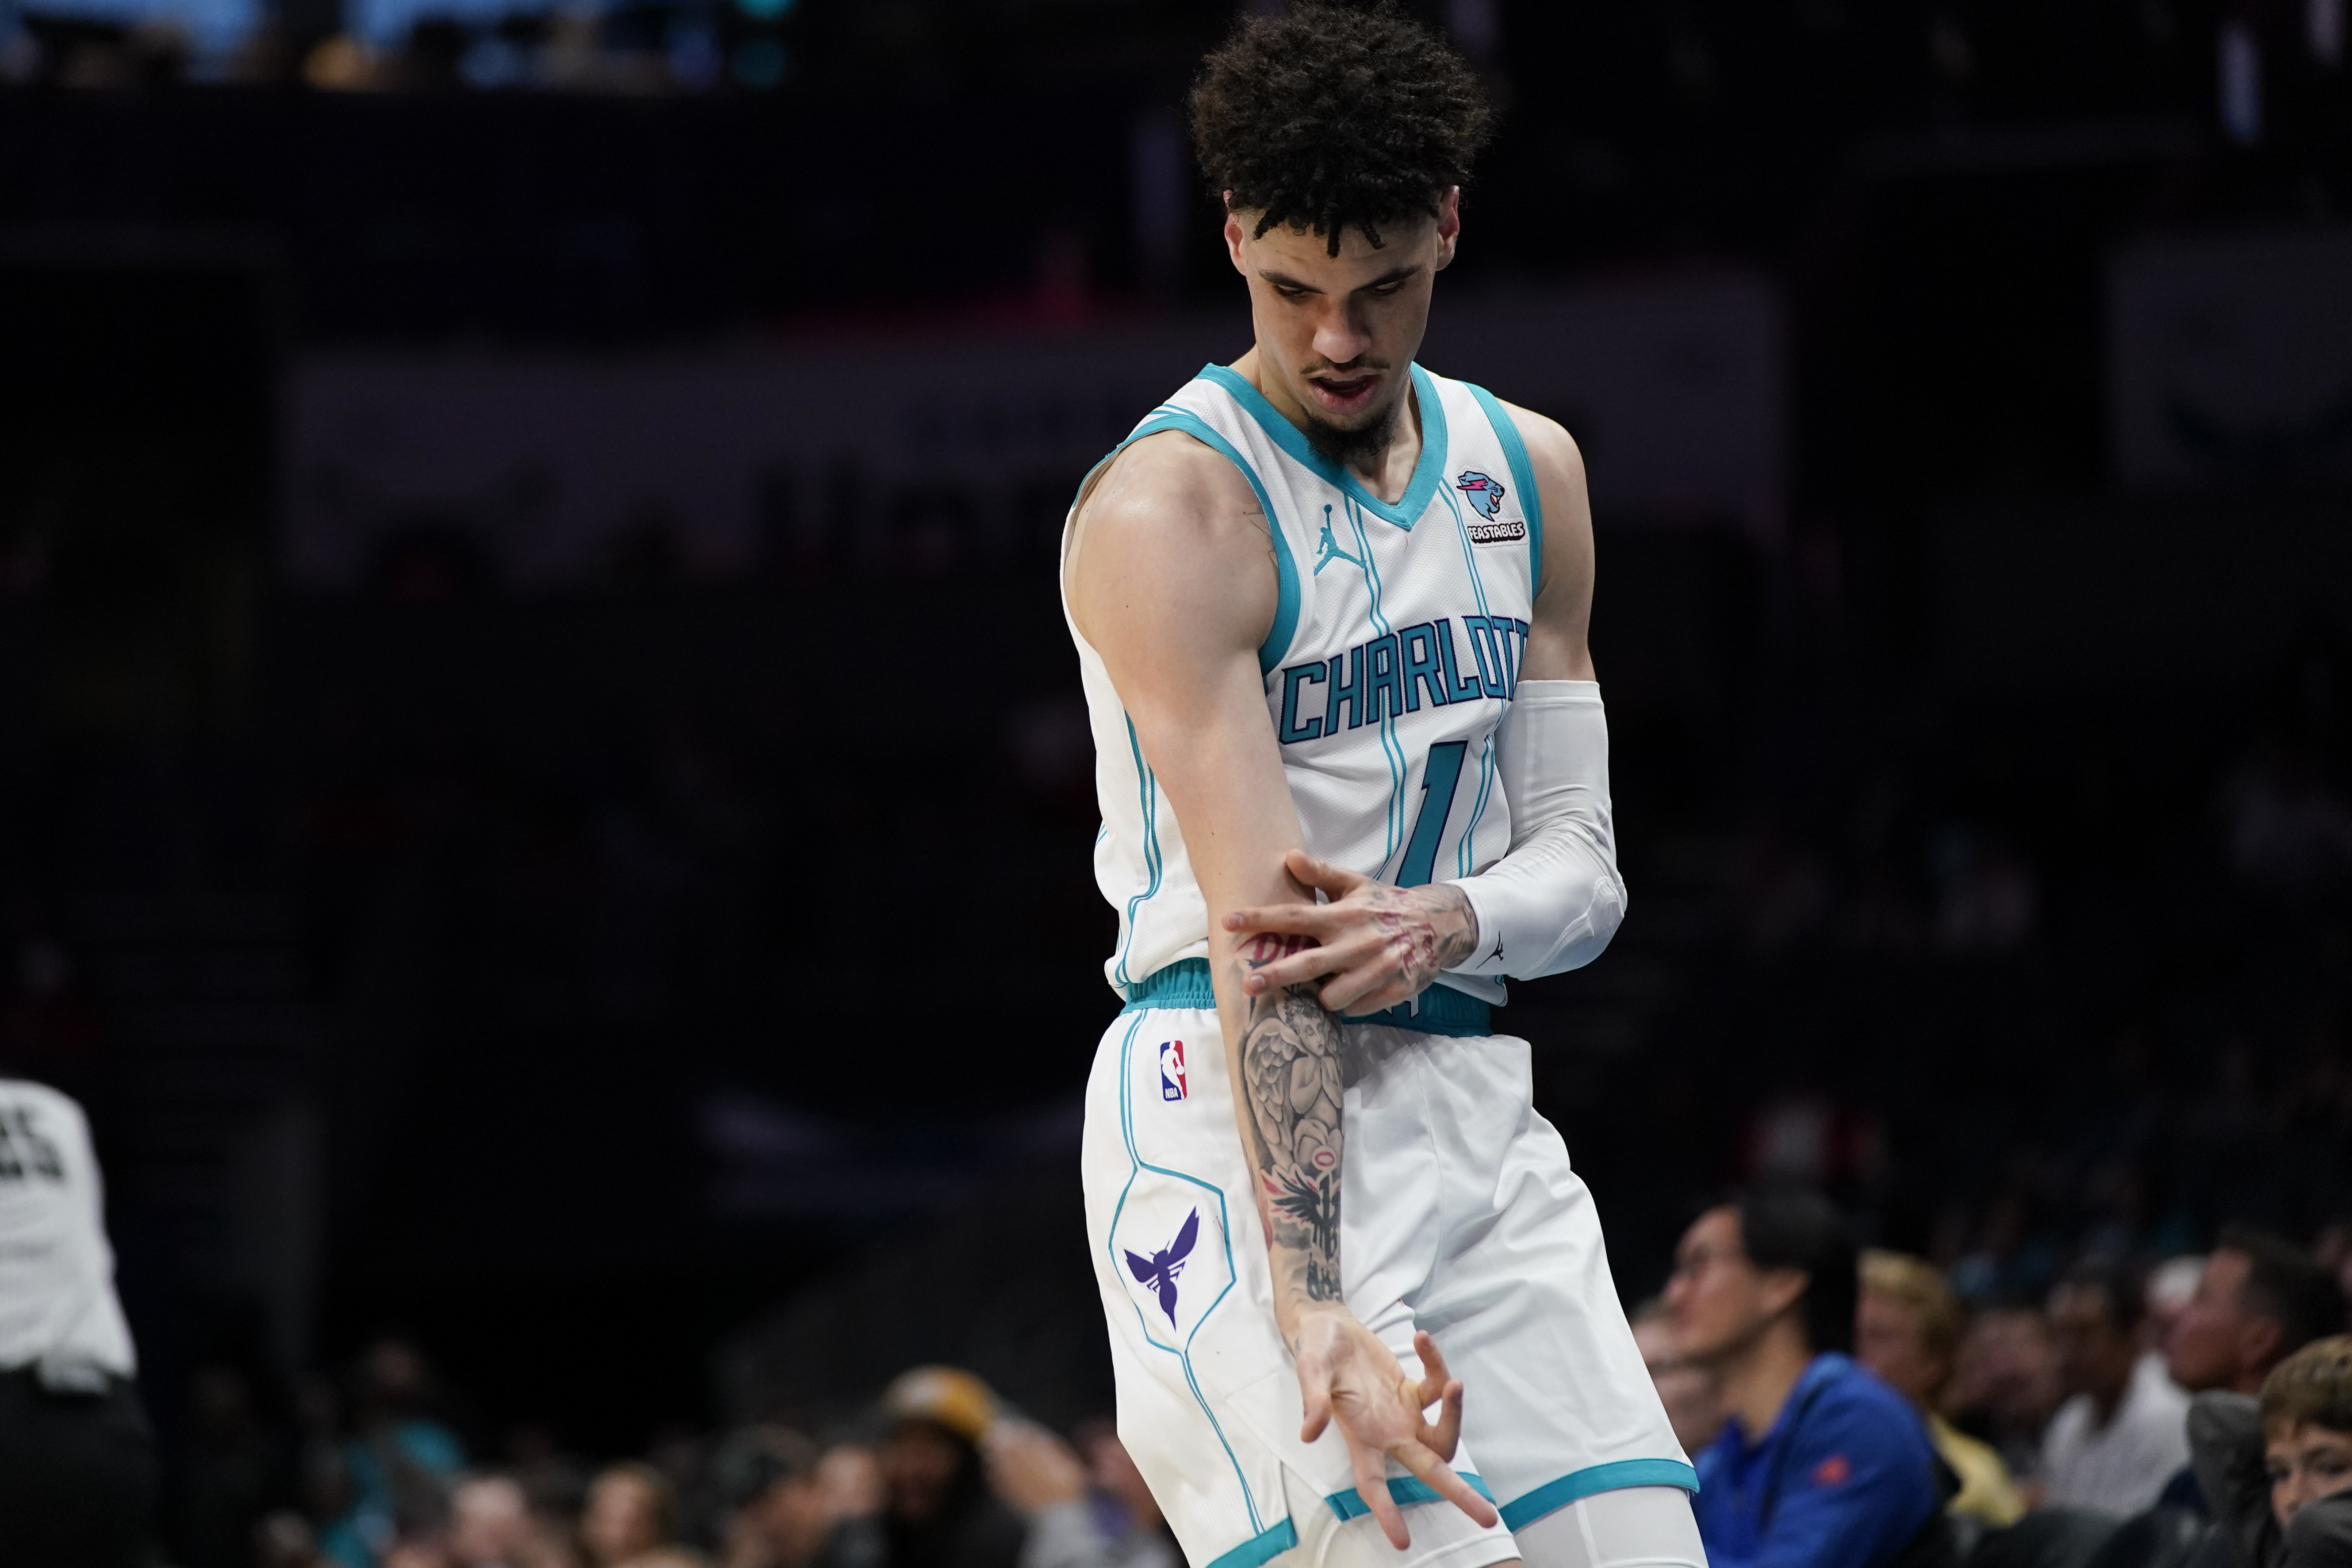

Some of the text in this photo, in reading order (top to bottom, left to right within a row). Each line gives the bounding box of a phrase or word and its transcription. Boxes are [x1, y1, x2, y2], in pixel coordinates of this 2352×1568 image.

[1467, 522, 1525, 544] FEASTABLES
[1394, 740, 1468, 888] 1
[1165, 1087, 1179, 1099] NBA
